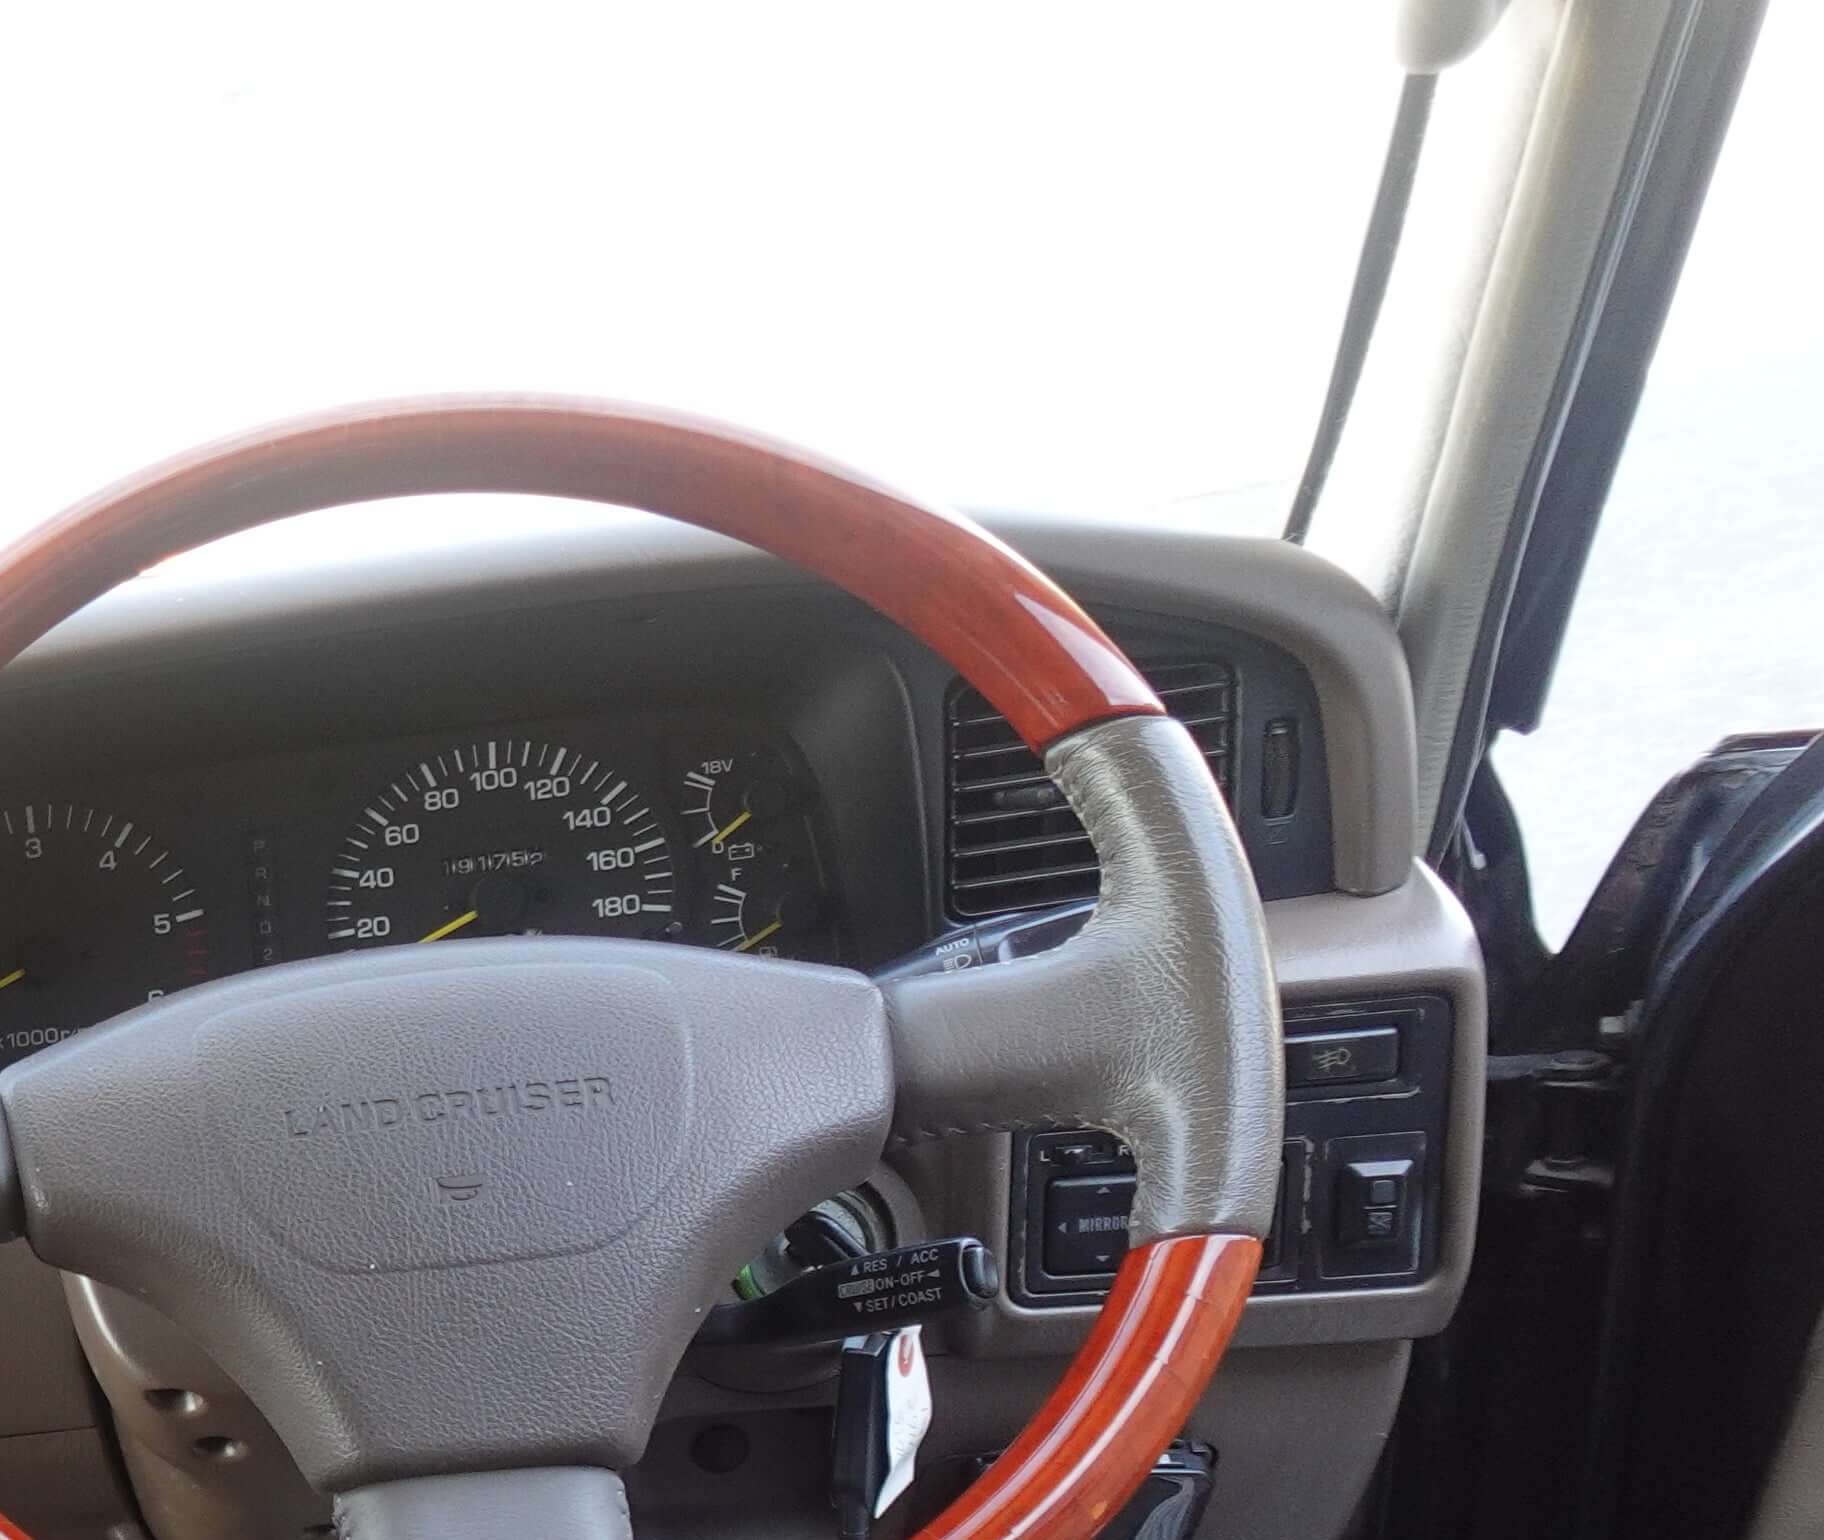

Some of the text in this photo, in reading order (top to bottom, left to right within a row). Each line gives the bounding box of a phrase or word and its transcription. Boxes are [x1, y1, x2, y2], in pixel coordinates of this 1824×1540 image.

[701, 758, 734, 775] 18V
[469, 767, 518, 792] 100
[523, 776, 571, 801] 120
[424, 788, 460, 811] 80
[562, 806, 611, 831] 140
[384, 823, 420, 847] 60
[25, 837, 42, 859] 3
[586, 847, 635, 871] 160
[99, 850, 117, 871] 4
[359, 867, 394, 889] 40
[731, 867, 742, 881] F
[591, 894, 641, 918] 180
[153, 913, 171, 934] 5
[356, 915, 391, 938] 20
[935, 937, 970, 956] AUTO
[285, 1076, 616, 1136] LAND CRUISER
[1040, 1144, 1130, 1161] L R
[1078, 1215, 1129, 1233] MIRROR
[863, 1258, 889, 1274] RES
[911, 1248, 939, 1265] ACC
[875, 1270, 926, 1290] ON-OFF
